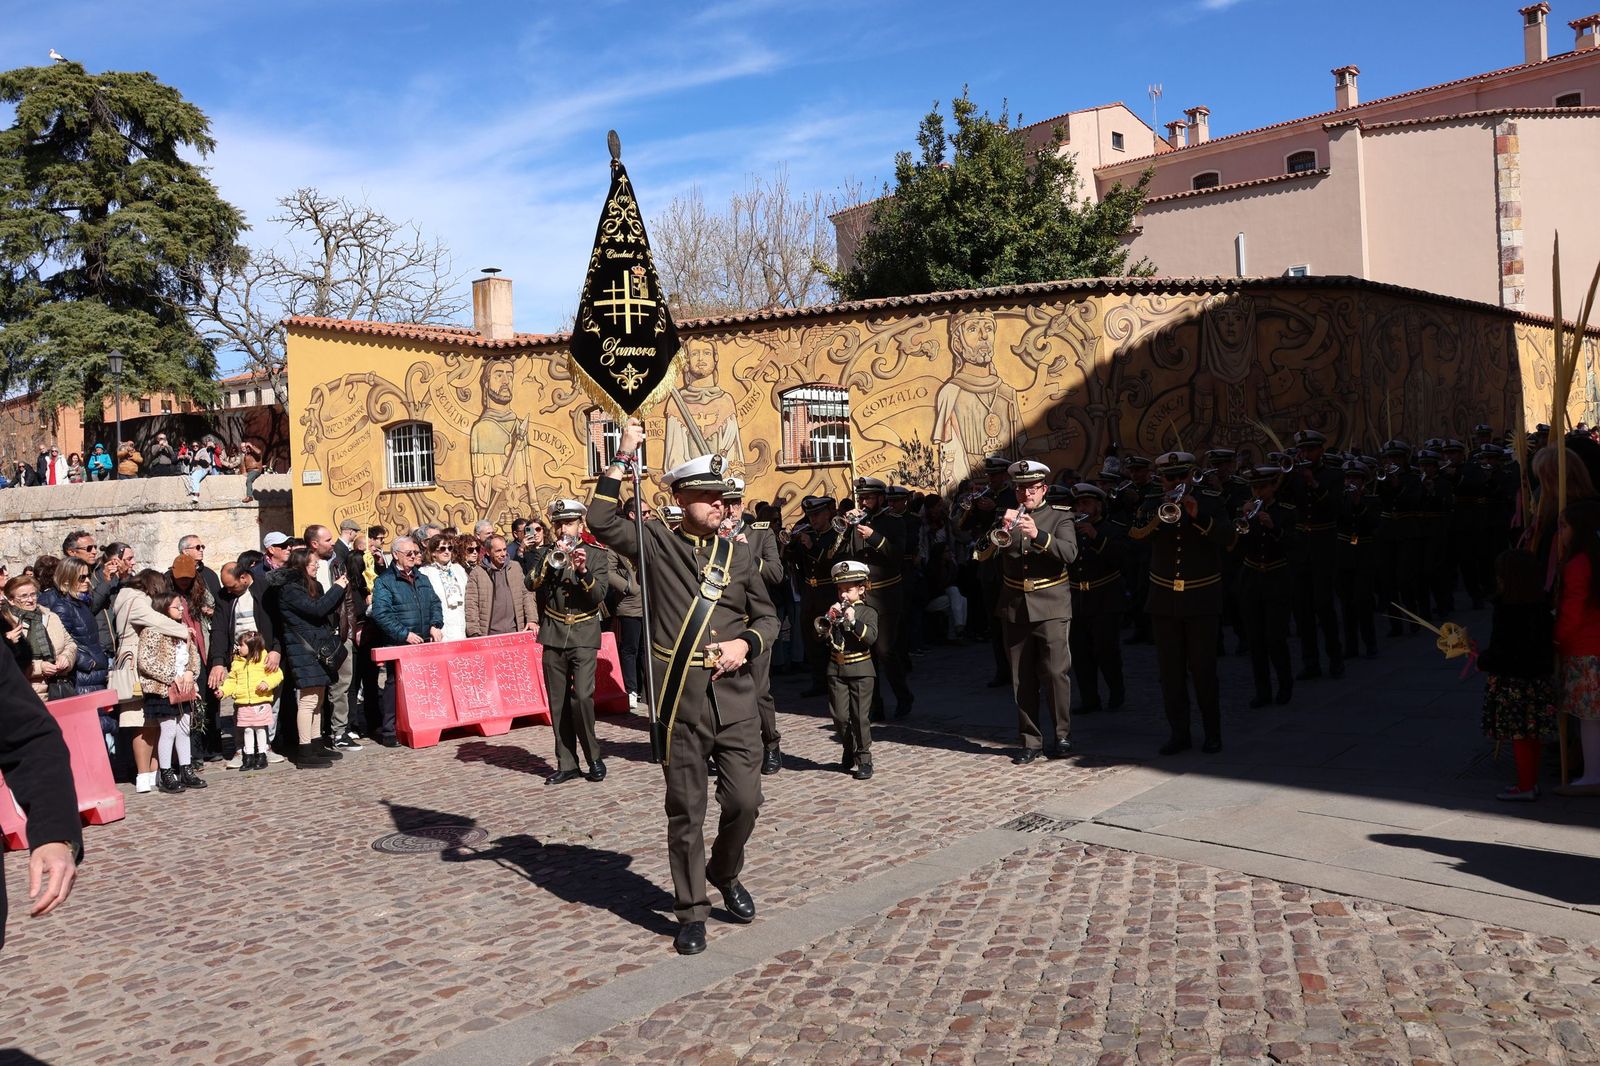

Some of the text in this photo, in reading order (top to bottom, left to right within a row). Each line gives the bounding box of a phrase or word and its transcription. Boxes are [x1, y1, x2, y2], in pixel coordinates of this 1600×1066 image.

[605, 248, 644, 260] Ciudad de
[600, 336, 656, 366] Zamora
[435, 386, 469, 428] BELLIDO
[862, 386, 928, 418] GONZALO
